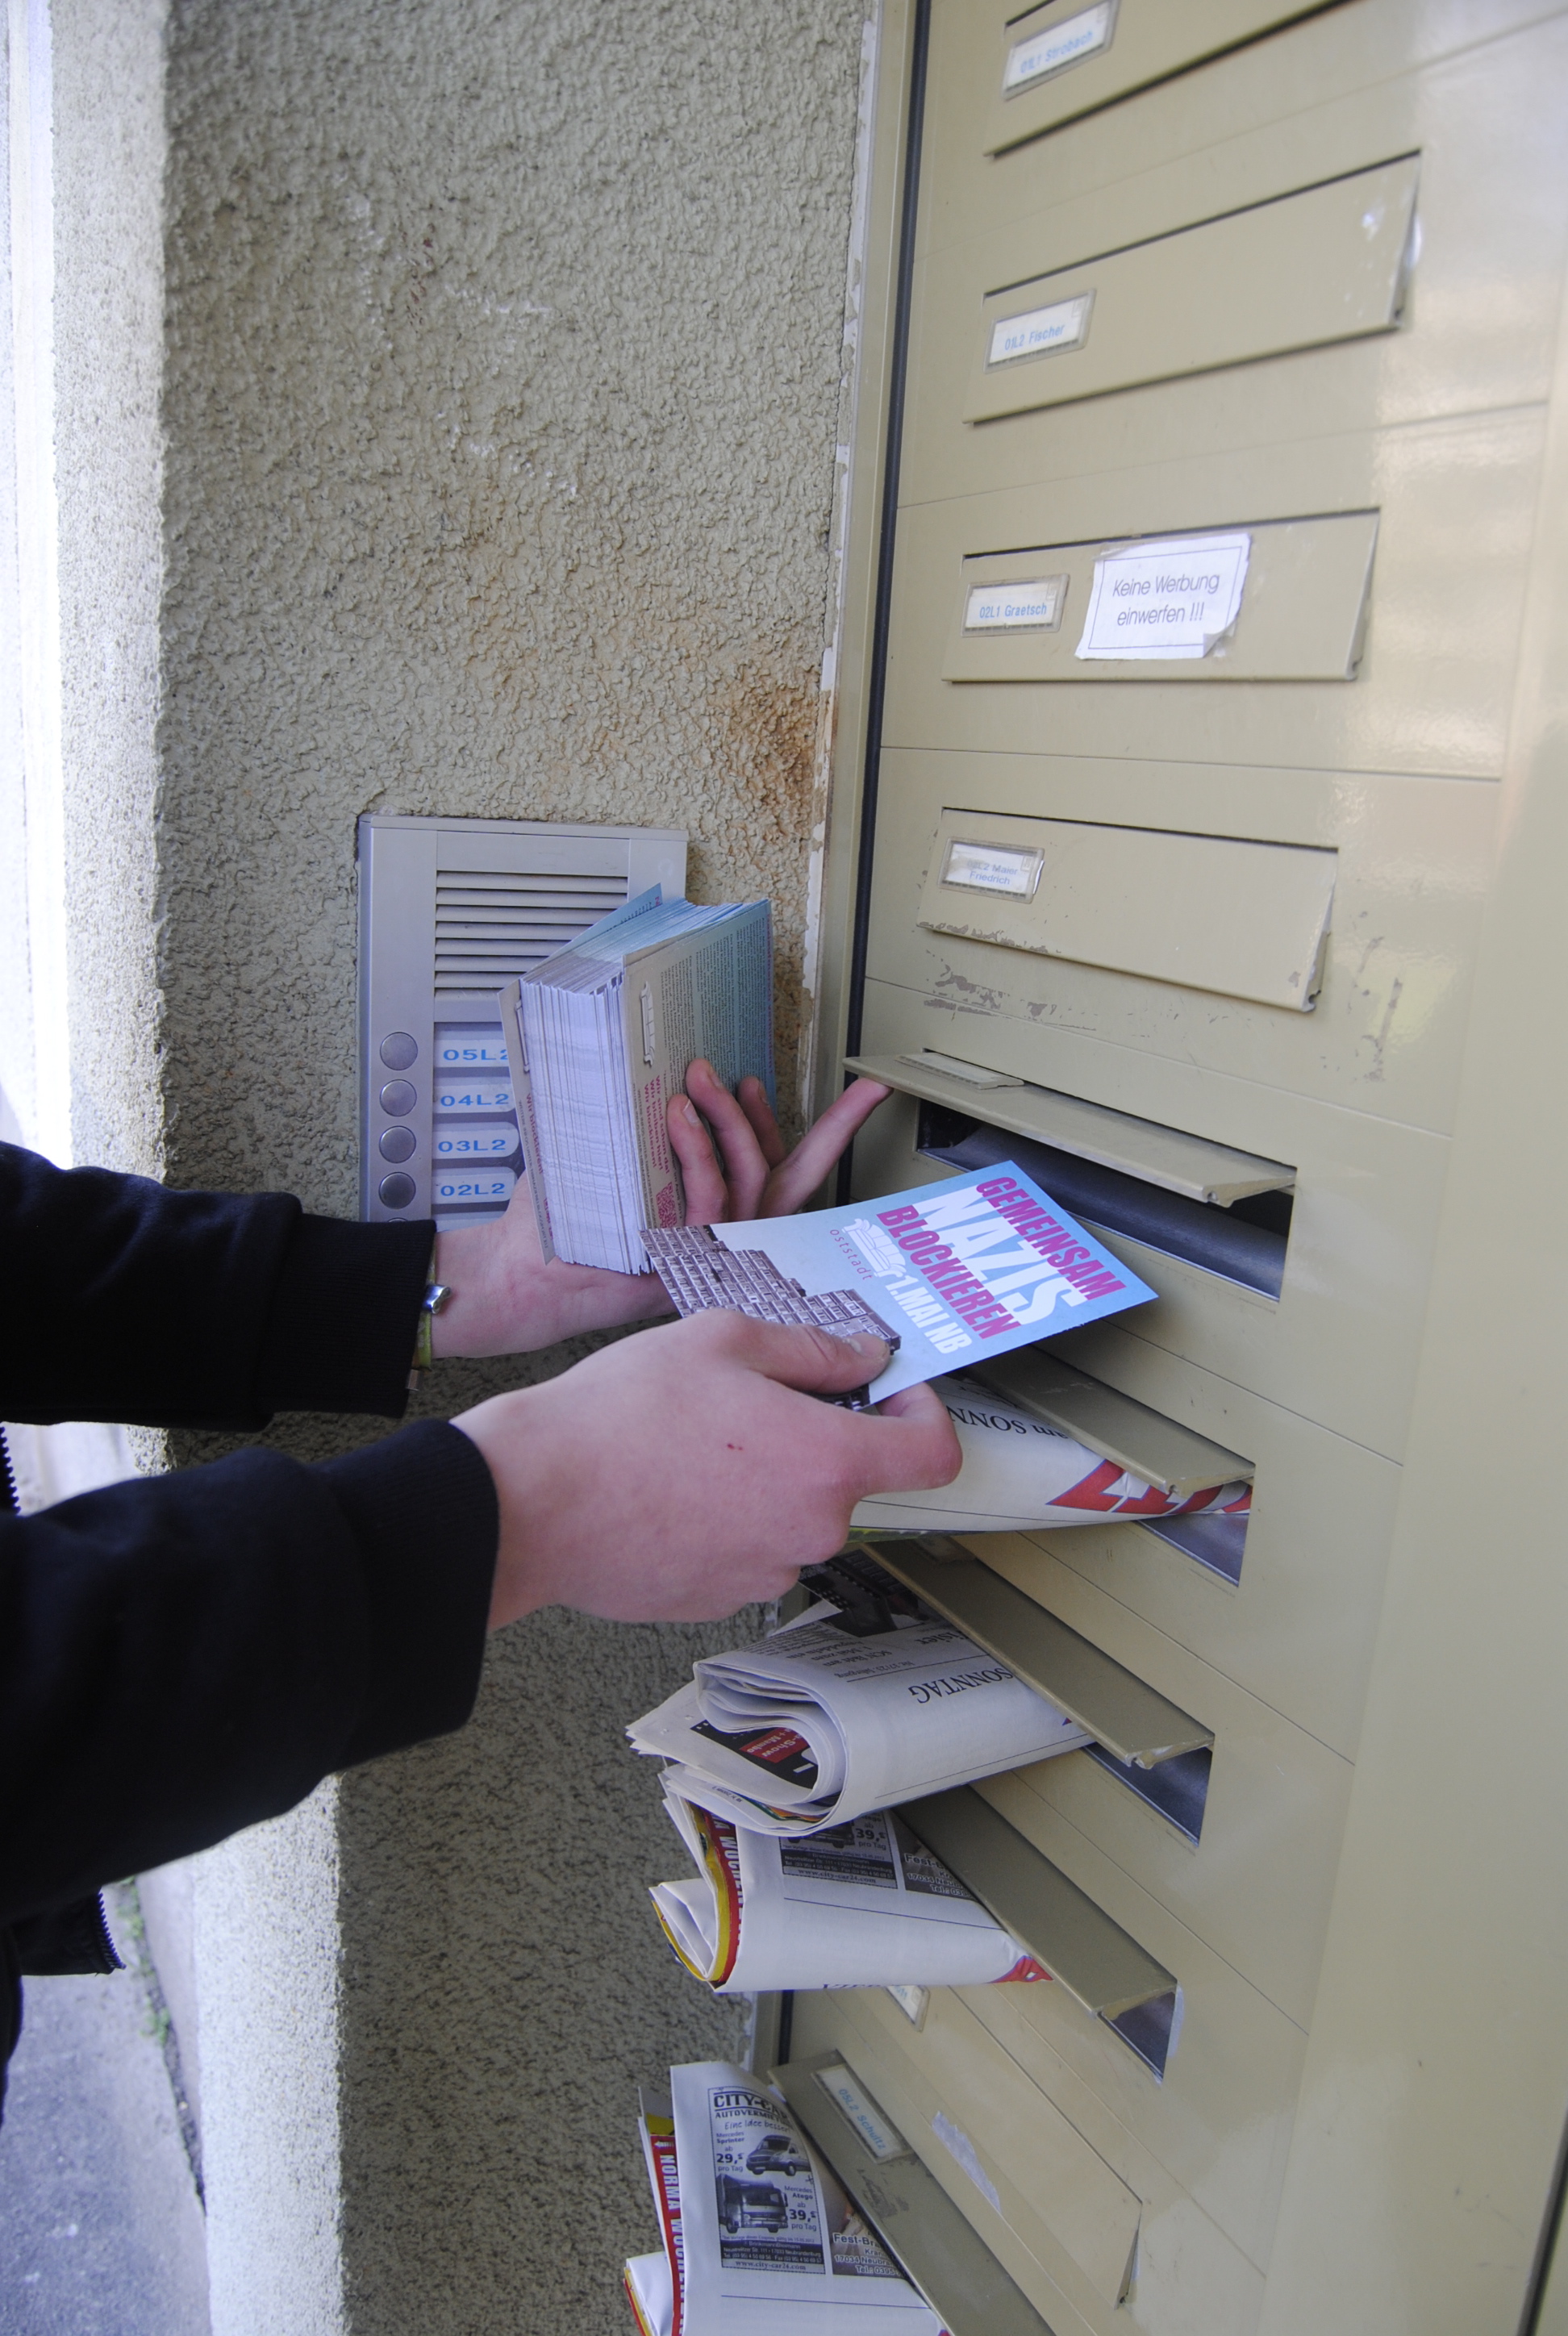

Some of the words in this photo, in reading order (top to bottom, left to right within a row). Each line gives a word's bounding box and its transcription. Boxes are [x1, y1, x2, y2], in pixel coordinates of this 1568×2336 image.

[1004, 334, 1025, 350] 01L2
[1028, 325, 1065, 344] Fischer
[1112, 578, 1151, 597] Keine
[1156, 574, 1220, 595] Werbung
[979, 606, 1000, 619] 02L1
[1004, 603, 1047, 617] Graetsch
[1117, 604, 1186, 626] einwerfen
[1189, 602, 1205, 621] !!!
[970, 871, 1010, 885] Friedrich
[440, 1093, 509, 1107] 04L2
[438, 1139, 507, 1153] 03L2
[440, 1183, 506, 1196] 02L2
[976, 1177, 1127, 1300] GEMEINSAM
[830, 1229, 873, 1281] oststadt
[913, 1185, 1089, 1324] NAZIS
[876, 1204, 1021, 1339] BLOCKIEREN
[924, 1312, 973, 1354] NB
[907, 1668, 1013, 1704] SONNTAG
[746, 1735, 782, 1754] Mambo
[873, 1842, 886, 1850] Tag
[724, 2121, 742, 2130] Eine
[659, 2155, 681, 2211] NORMA
[784, 2185, 813, 2193] Mercedes
[792, 2192, 813, 2200] Atego
[804, 2223, 817, 2232] Tag
[736, 2260, 807, 2271] www.city-car24.com
